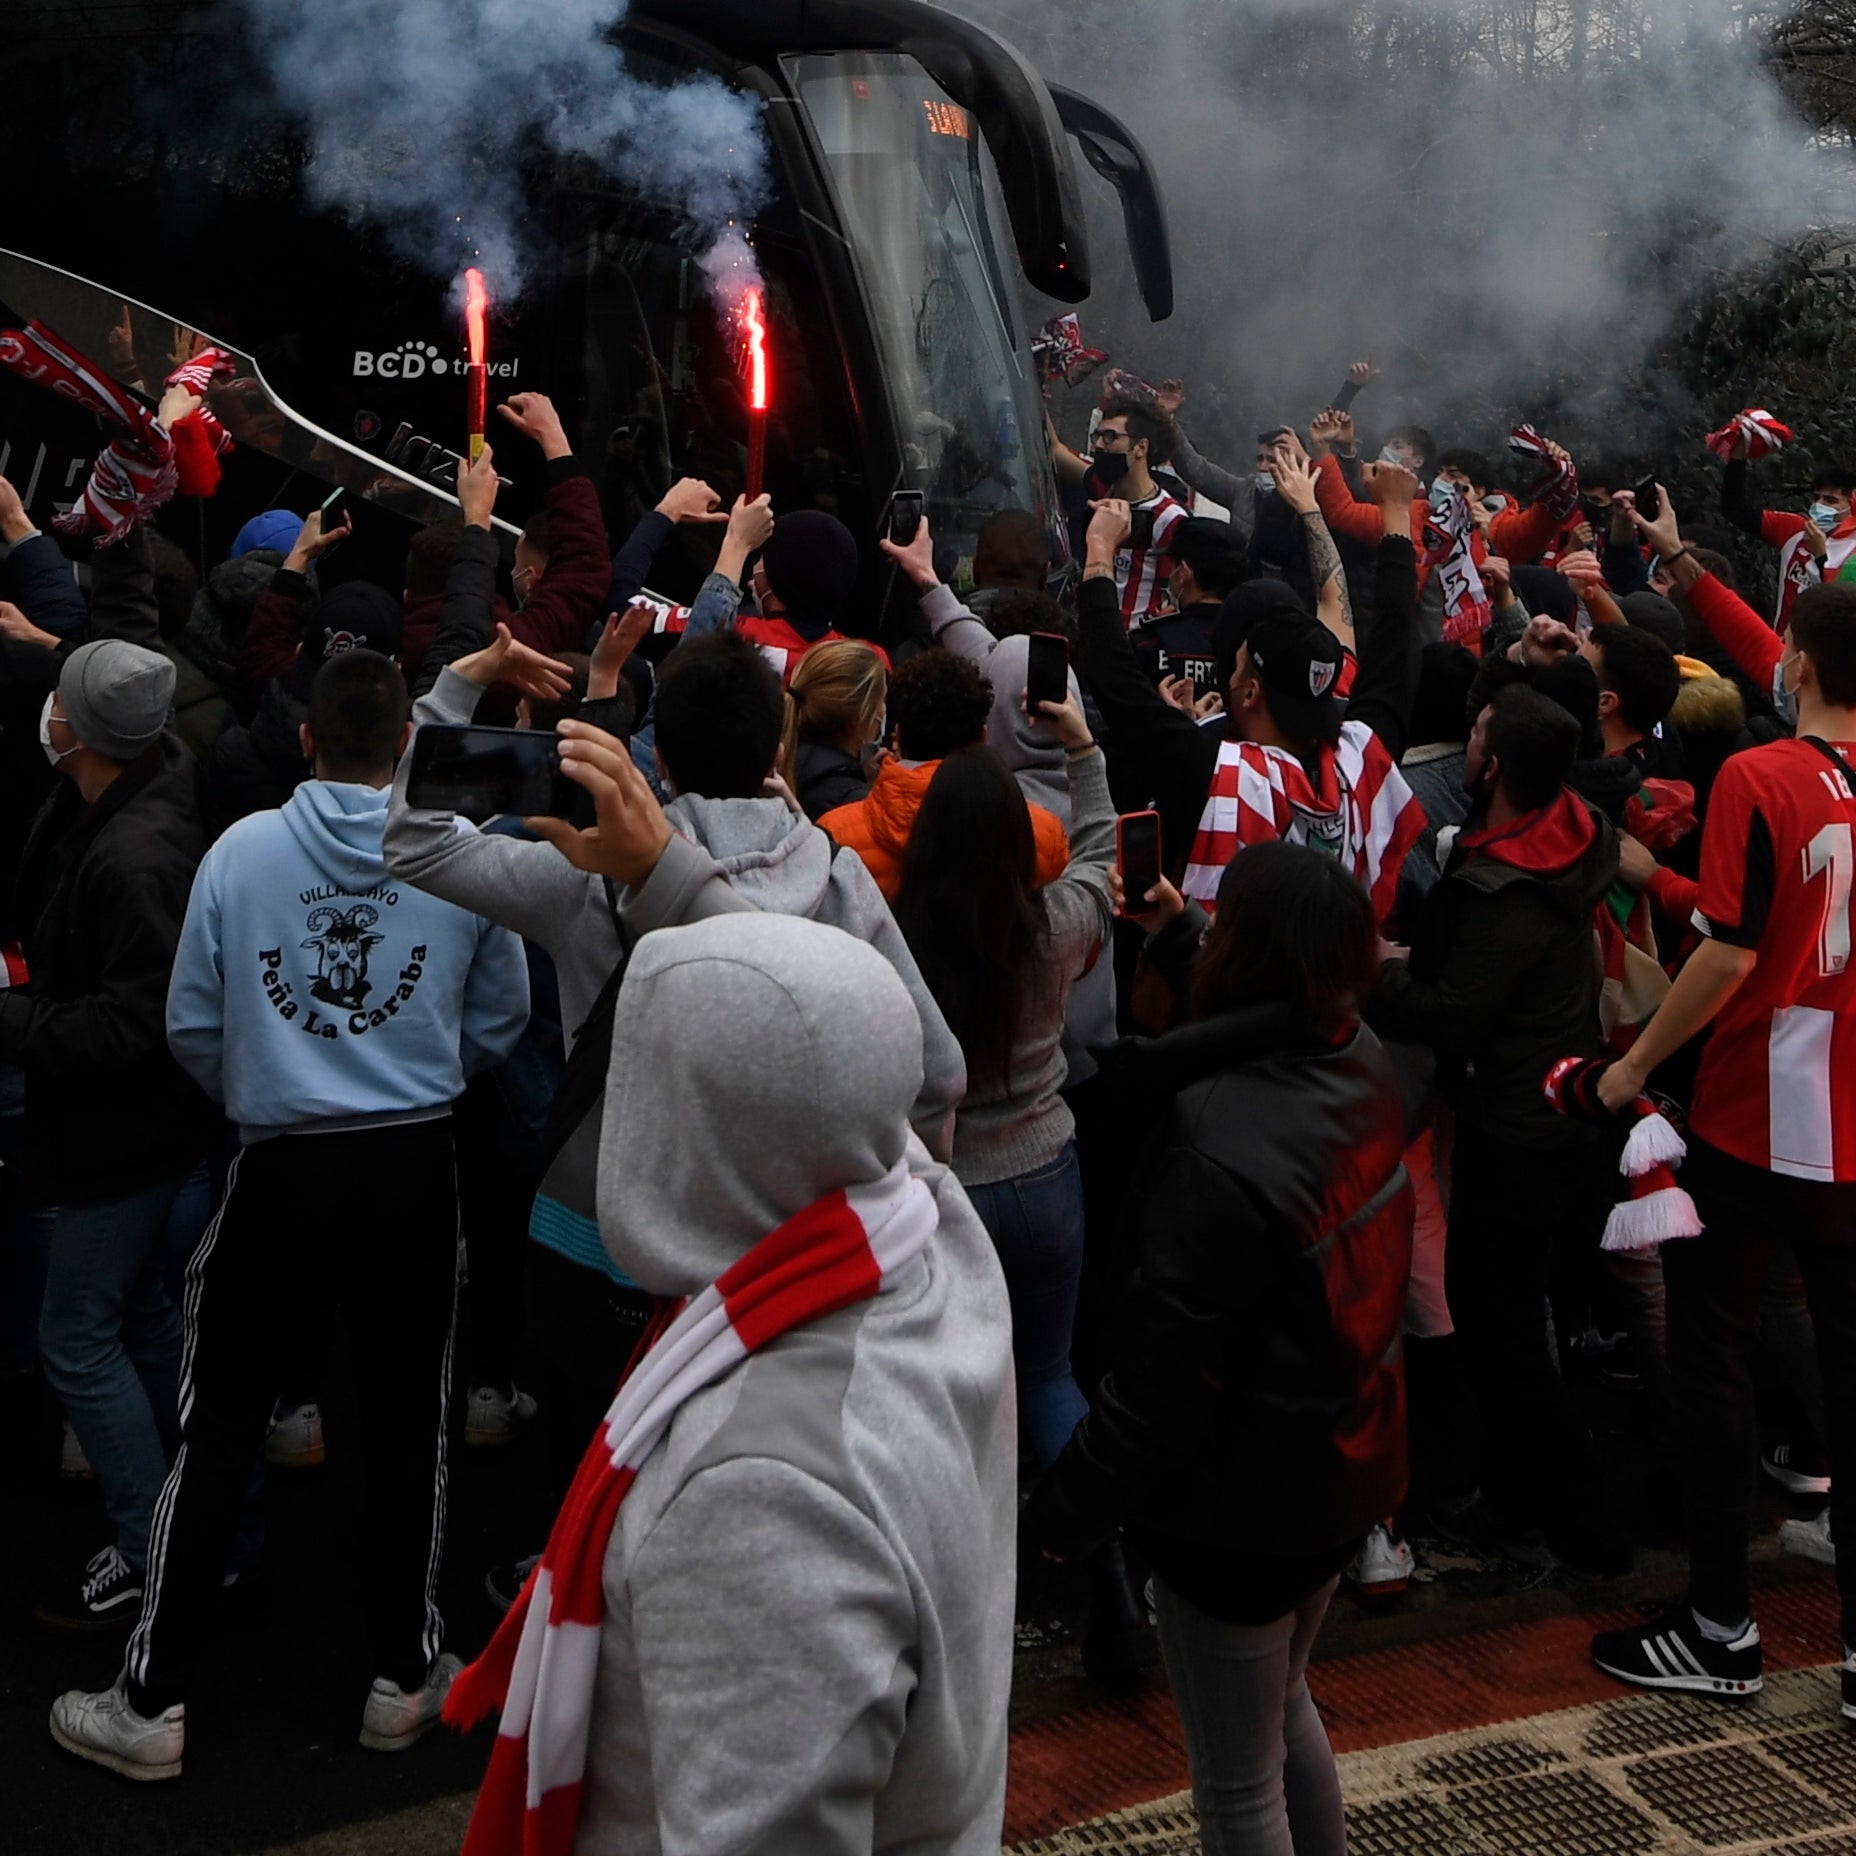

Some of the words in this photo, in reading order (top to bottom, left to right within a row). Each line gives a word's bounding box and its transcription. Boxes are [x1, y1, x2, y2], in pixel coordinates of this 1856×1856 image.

[352, 350, 426, 379] BCD
[452, 357, 520, 378] trvel
[259, 947, 300, 1021] Peña
[302, 1010, 338, 1039] La
[348, 944, 428, 1036] Caraba
